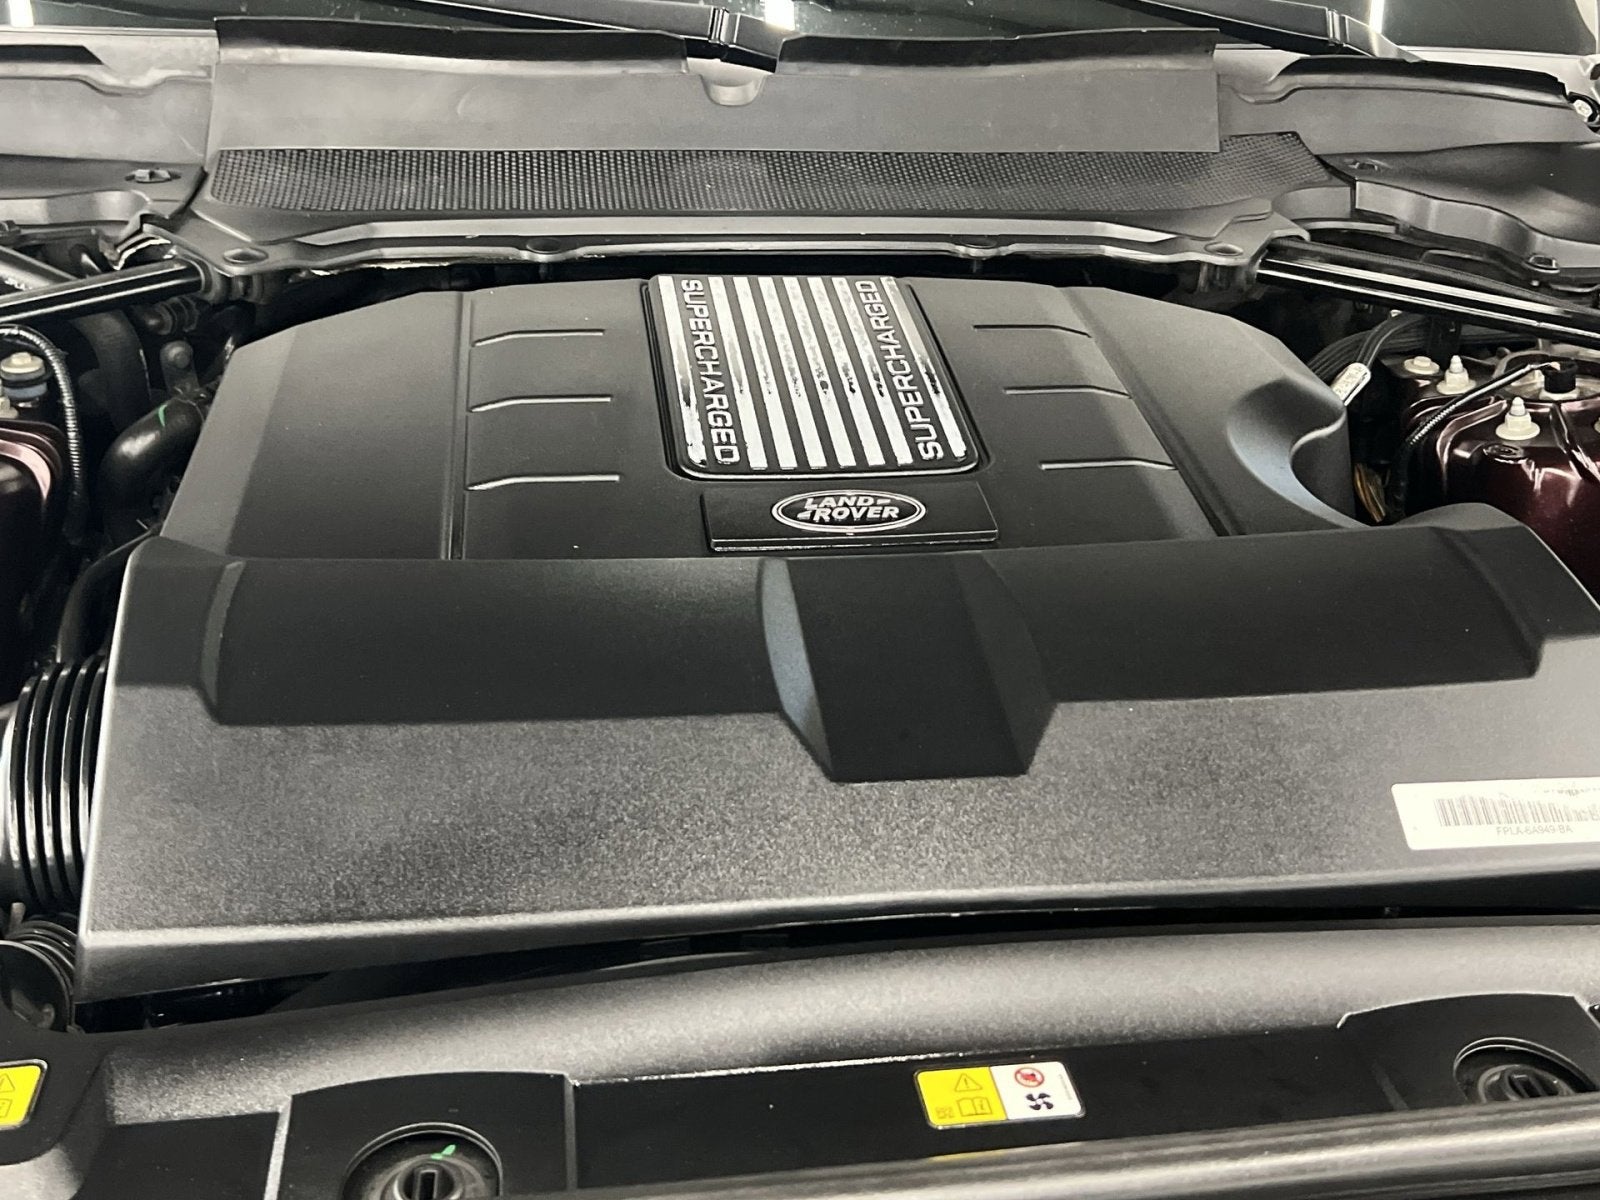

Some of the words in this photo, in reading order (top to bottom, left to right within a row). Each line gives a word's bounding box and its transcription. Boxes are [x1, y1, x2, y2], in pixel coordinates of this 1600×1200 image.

[681, 279, 740, 464] SUPERCHARGED
[855, 280, 944, 460] SUPERCHARGED
[804, 496, 874, 510] LAND
[813, 506, 899, 522] ROVER
